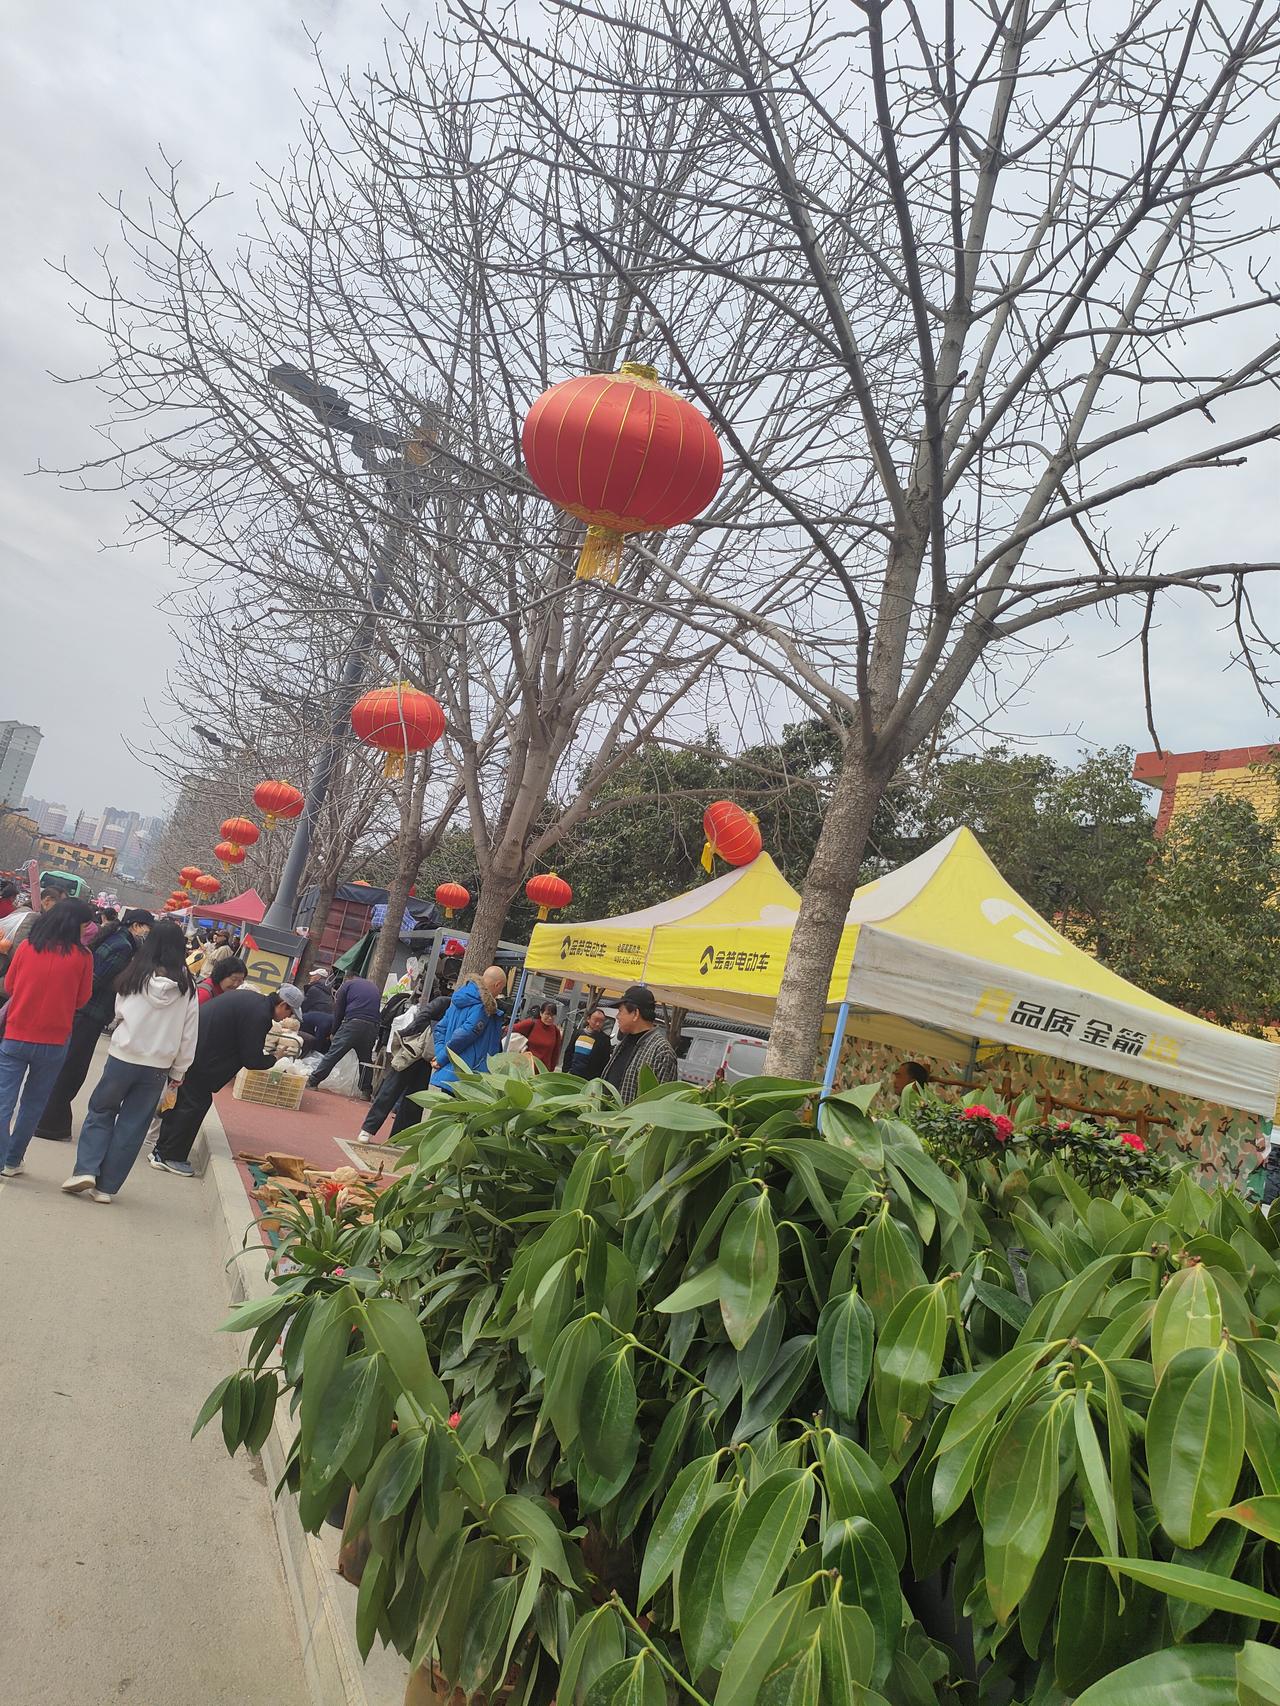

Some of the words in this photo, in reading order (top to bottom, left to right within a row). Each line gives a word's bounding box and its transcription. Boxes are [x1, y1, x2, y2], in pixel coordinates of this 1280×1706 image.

[713, 950, 771, 972] 金箭电动车
